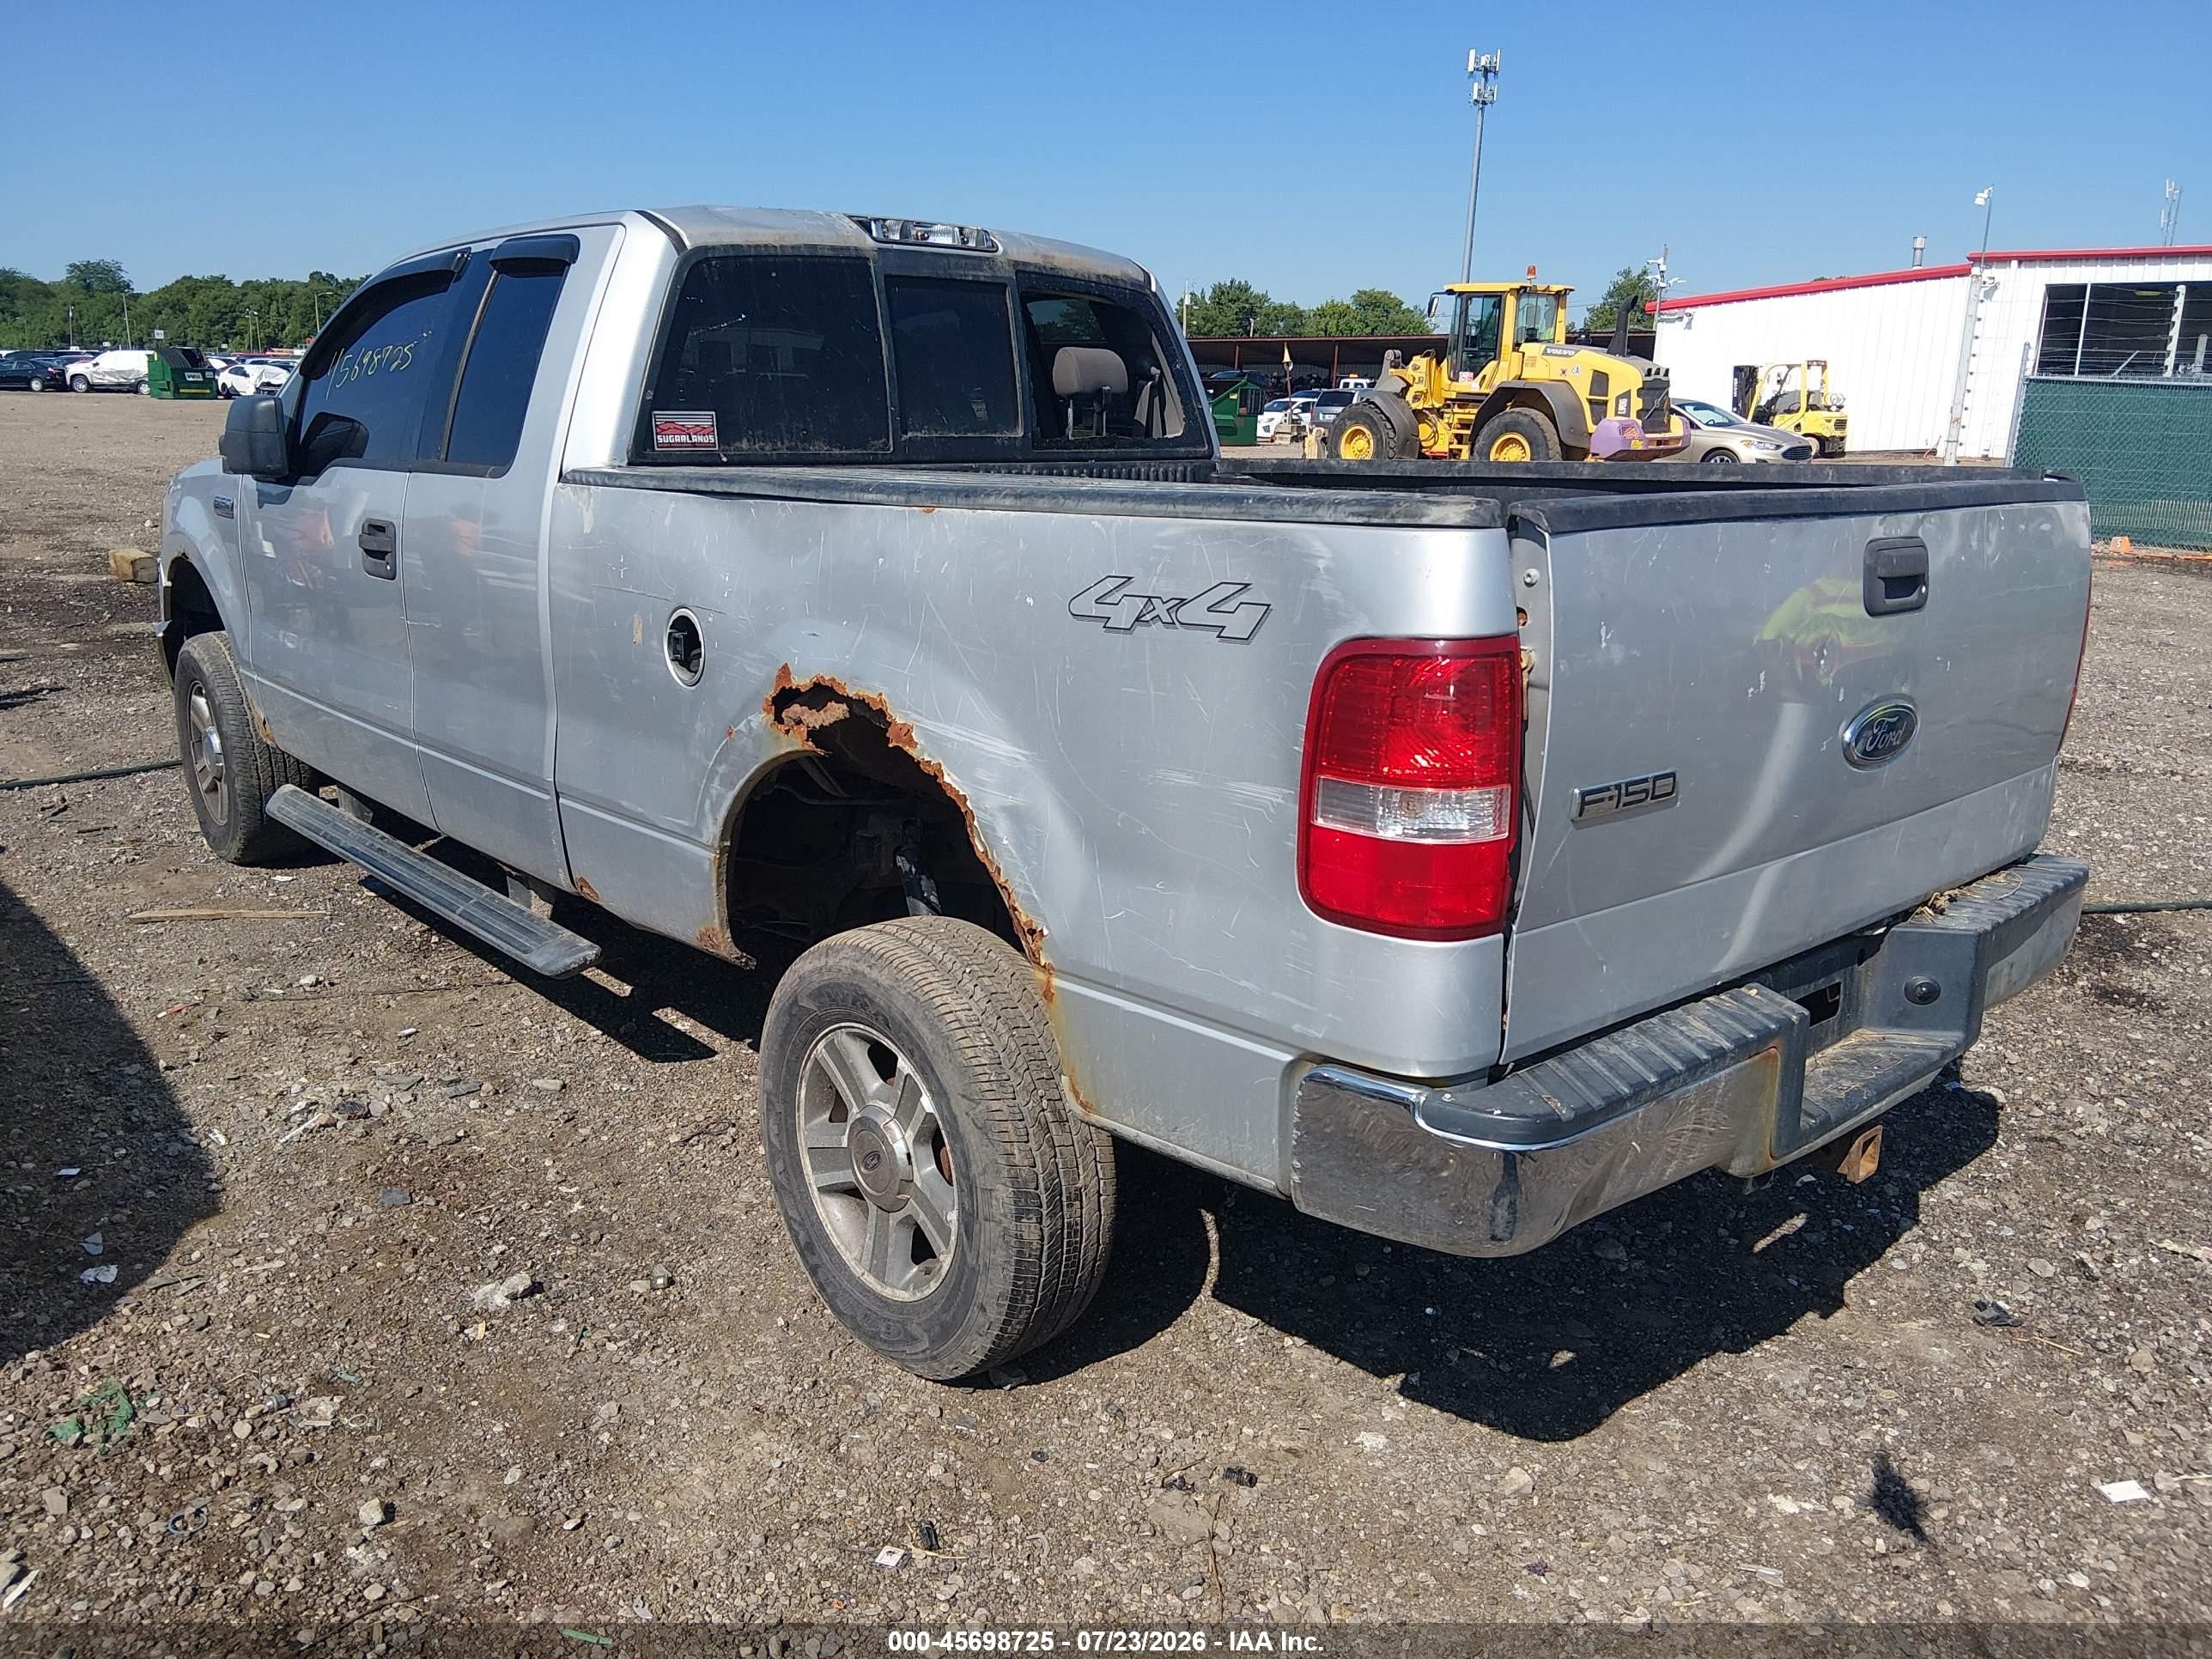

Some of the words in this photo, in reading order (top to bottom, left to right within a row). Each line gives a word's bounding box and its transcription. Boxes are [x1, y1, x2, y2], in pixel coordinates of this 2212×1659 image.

[1546, 348, 1576, 356] VOLVO
[657, 434, 714, 443] SUGARLANDS
[1067, 574, 1273, 645] 4x4
[1865, 715, 1907, 752] Ford
[1578, 772, 1677, 817] F-150
